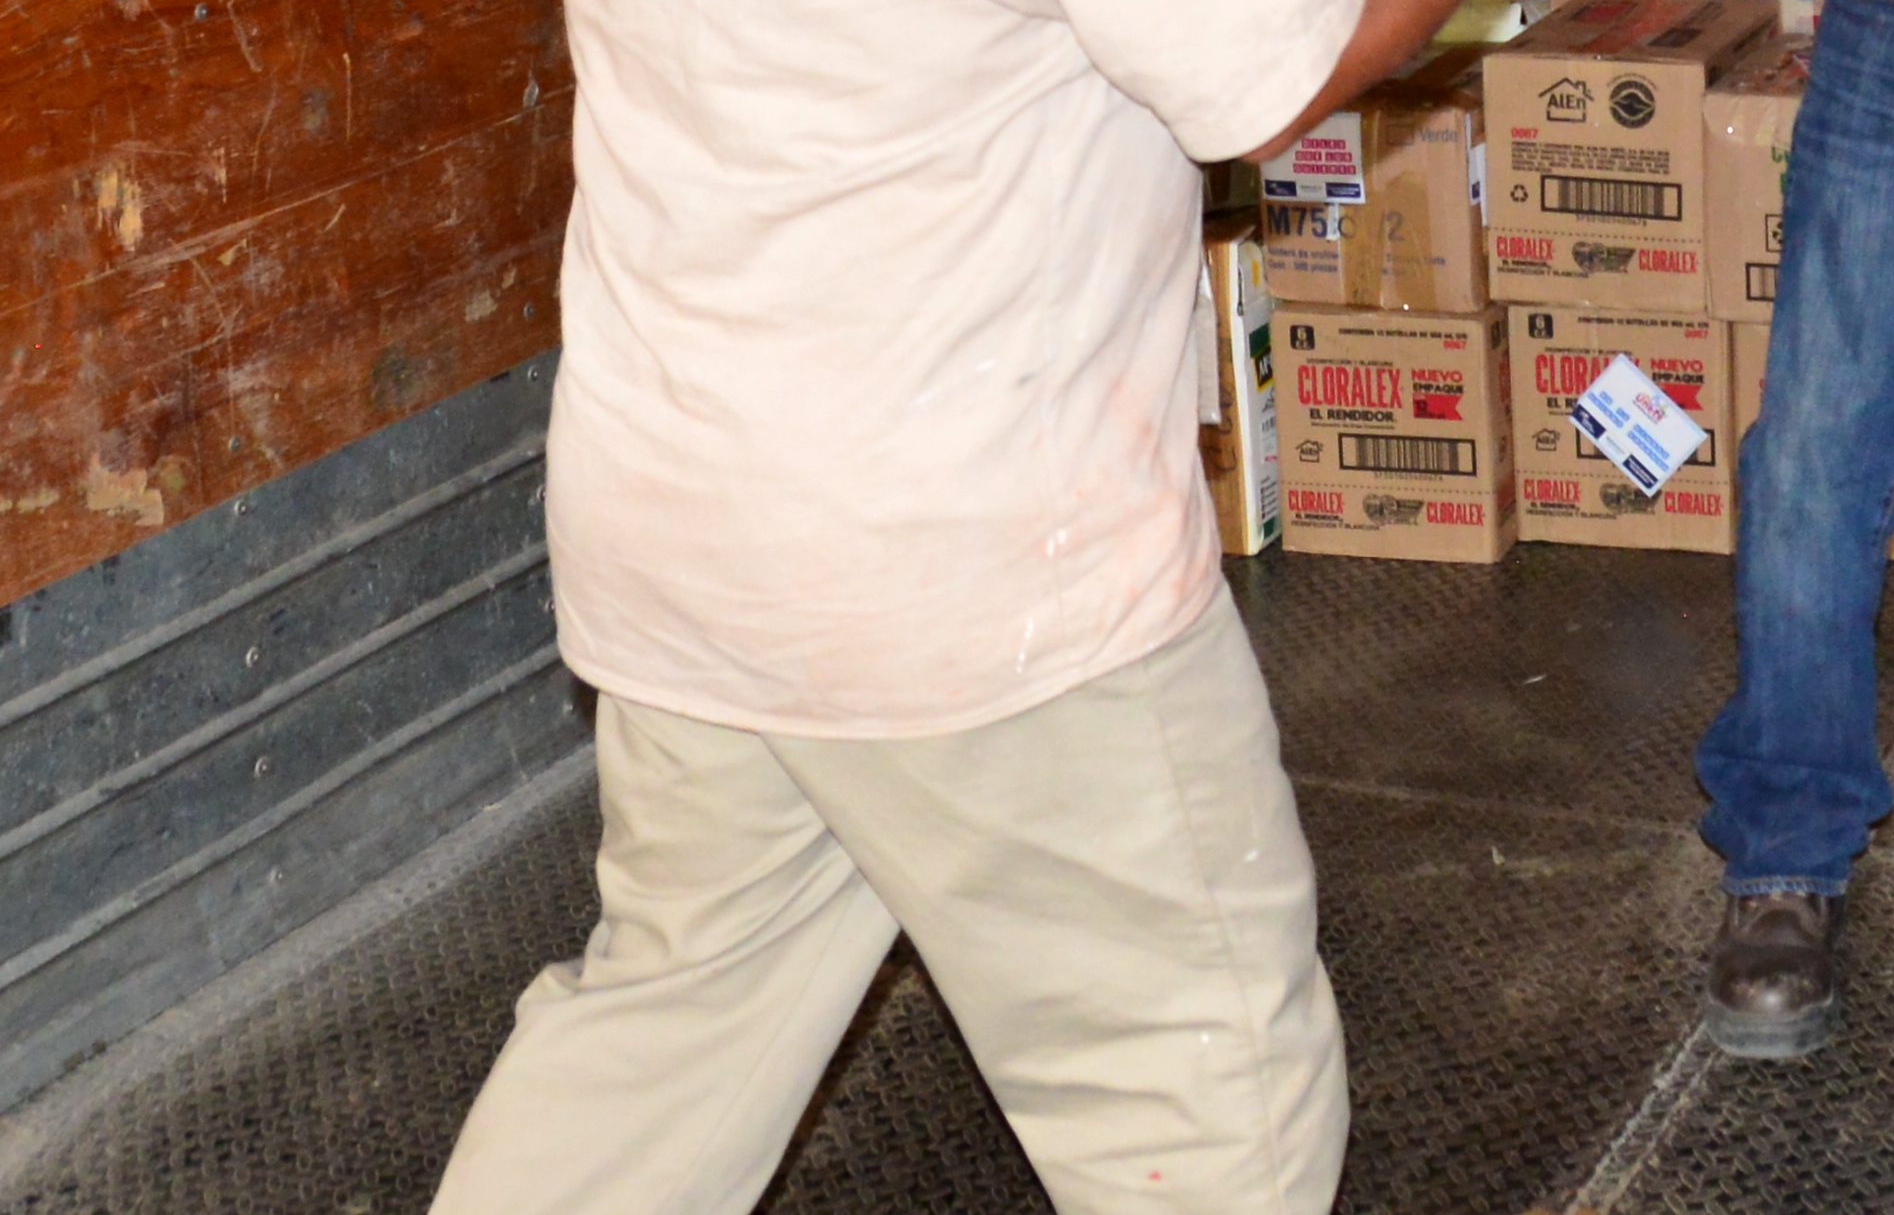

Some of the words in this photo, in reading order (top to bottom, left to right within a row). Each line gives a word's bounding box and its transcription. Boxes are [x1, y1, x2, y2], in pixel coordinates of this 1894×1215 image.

[1496, 235, 1553, 260] CLORALEX
[1638, 249, 1697, 274] CLORALEX
[1650, 358, 1704, 373] NUEVO
[1411, 369, 1464, 384] NUEVO
[1652, 372, 1705, 384] EMPAQUE
[1297, 364, 1403, 410] CLORALEX
[1412, 383, 1465, 395] EMPAQUE
[1546, 396, 1562, 409] EL
[1309, 408, 1324, 421] EL
[1523, 478, 1581, 504] CLORALEX
[1664, 490, 1722, 516] CLORALEX
[1288, 489, 1345, 515] CLORALEX
[1426, 501, 1485, 527] CLORALEX
